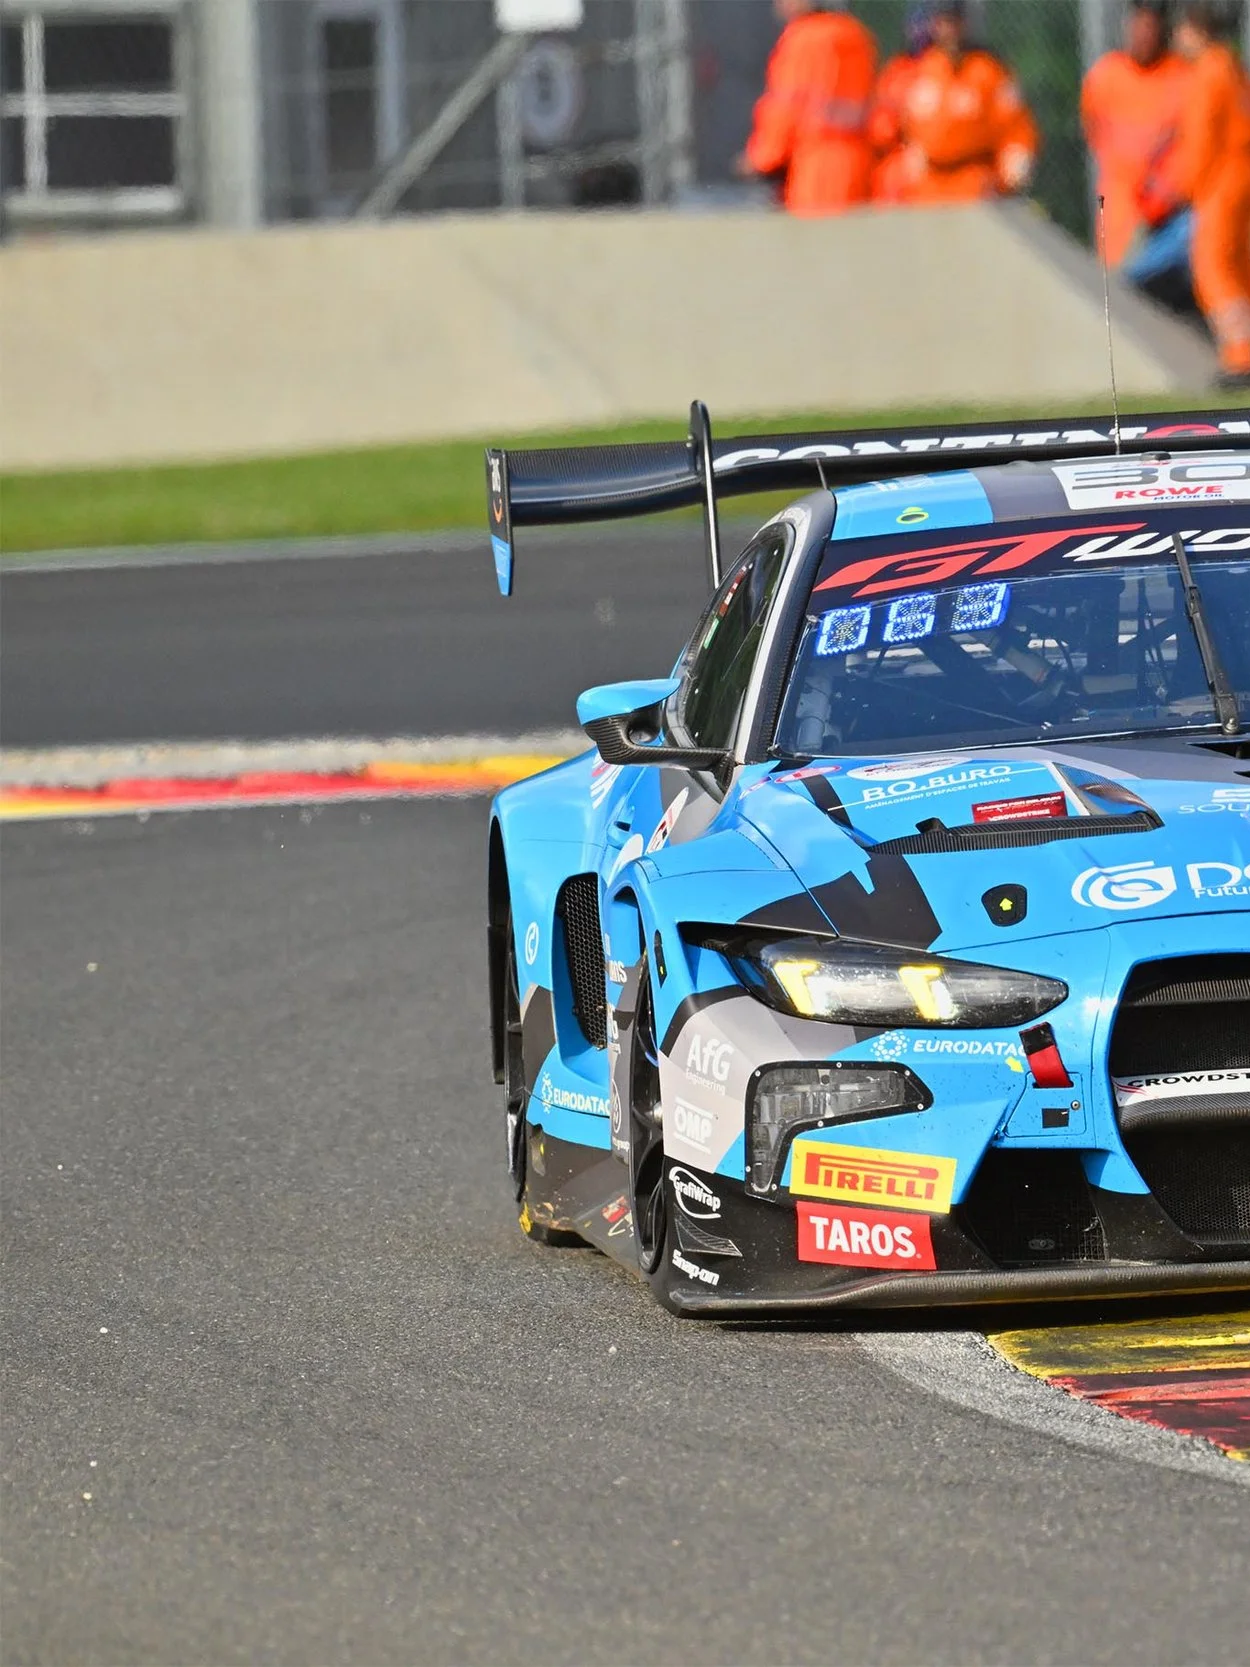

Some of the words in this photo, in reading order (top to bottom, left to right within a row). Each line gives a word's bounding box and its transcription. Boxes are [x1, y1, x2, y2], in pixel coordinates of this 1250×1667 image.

[1115, 485, 1225, 500] ROWE
[812, 523, 1148, 598] GT
[686, 1033, 735, 1082] AfG
[674, 1106, 713, 1144] OMP
[673, 1174, 722, 1212] GrafiWrap
[804, 1152, 940, 1200] PIRELLI
[809, 1215, 918, 1258] TAROS
[672, 1248, 720, 1286] Snap-on
